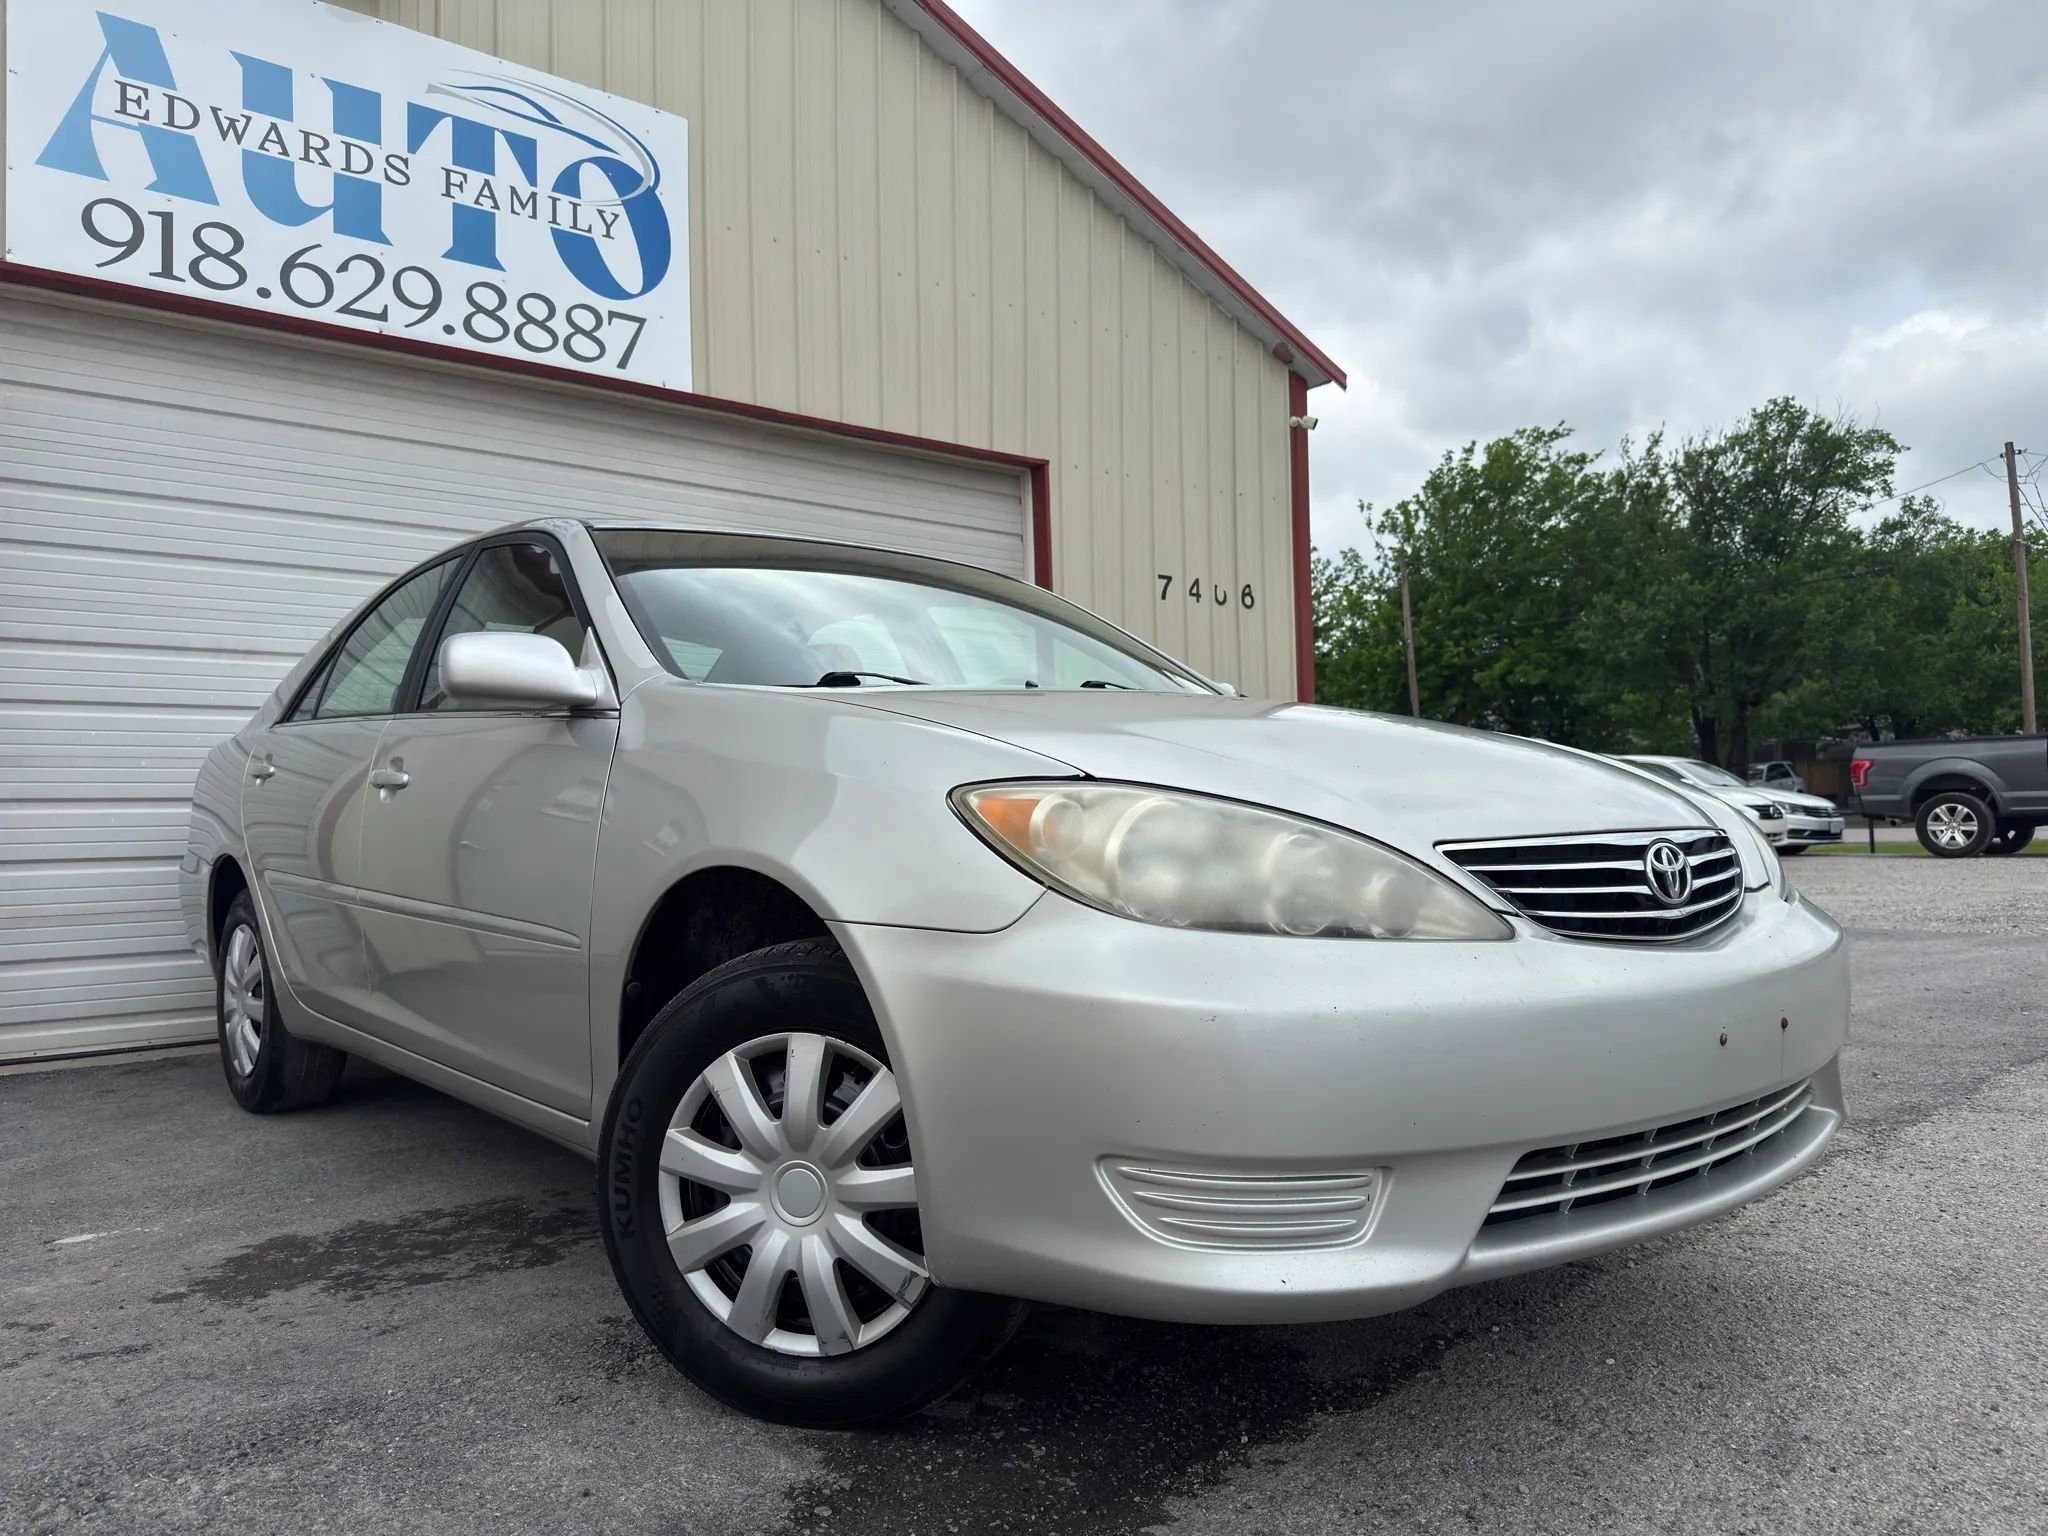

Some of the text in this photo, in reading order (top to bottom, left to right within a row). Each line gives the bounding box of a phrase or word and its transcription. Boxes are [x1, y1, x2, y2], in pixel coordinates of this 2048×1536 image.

[35, 10, 671, 300] AUTO
[114, 80, 620, 241] EDWARDS FAMILY
[81, 197, 648, 369] 918.629.8887
[614, 1098, 643, 1240] KUMHO
